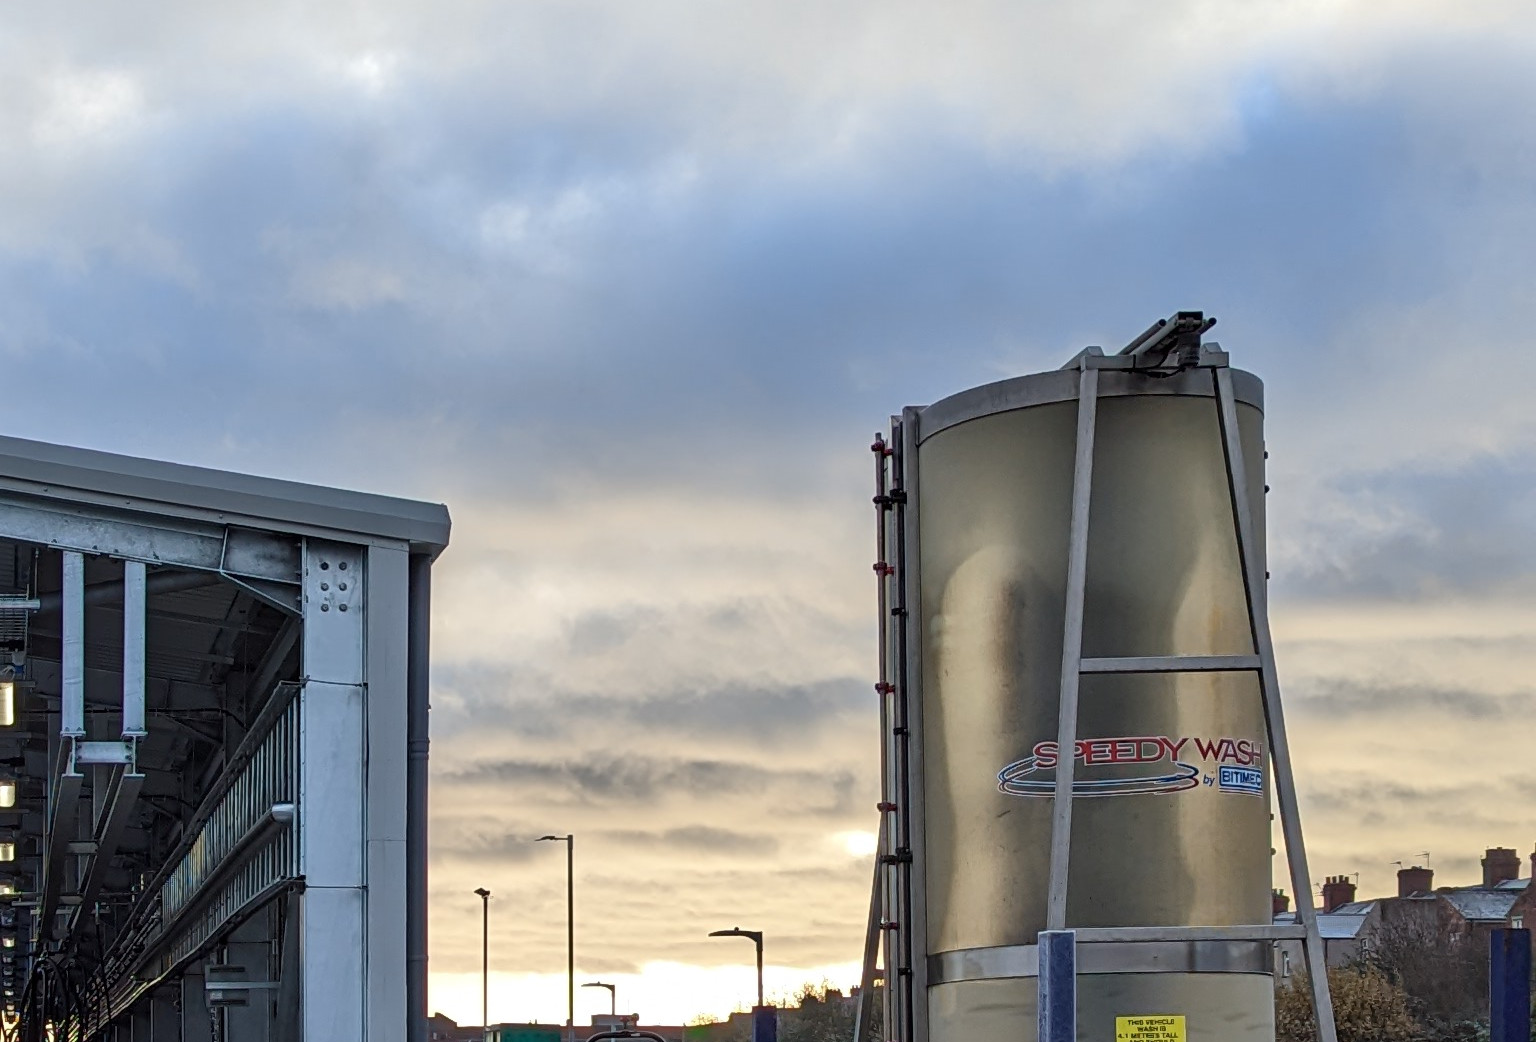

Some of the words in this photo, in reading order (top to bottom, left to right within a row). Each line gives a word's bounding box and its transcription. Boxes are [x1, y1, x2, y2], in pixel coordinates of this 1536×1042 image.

[1033, 736, 1189, 769] SPEEDY
[1193, 737, 1263, 766] WASH
[1203, 774, 1216, 787] by
[1221, 770, 1262, 786] BITIMEC
